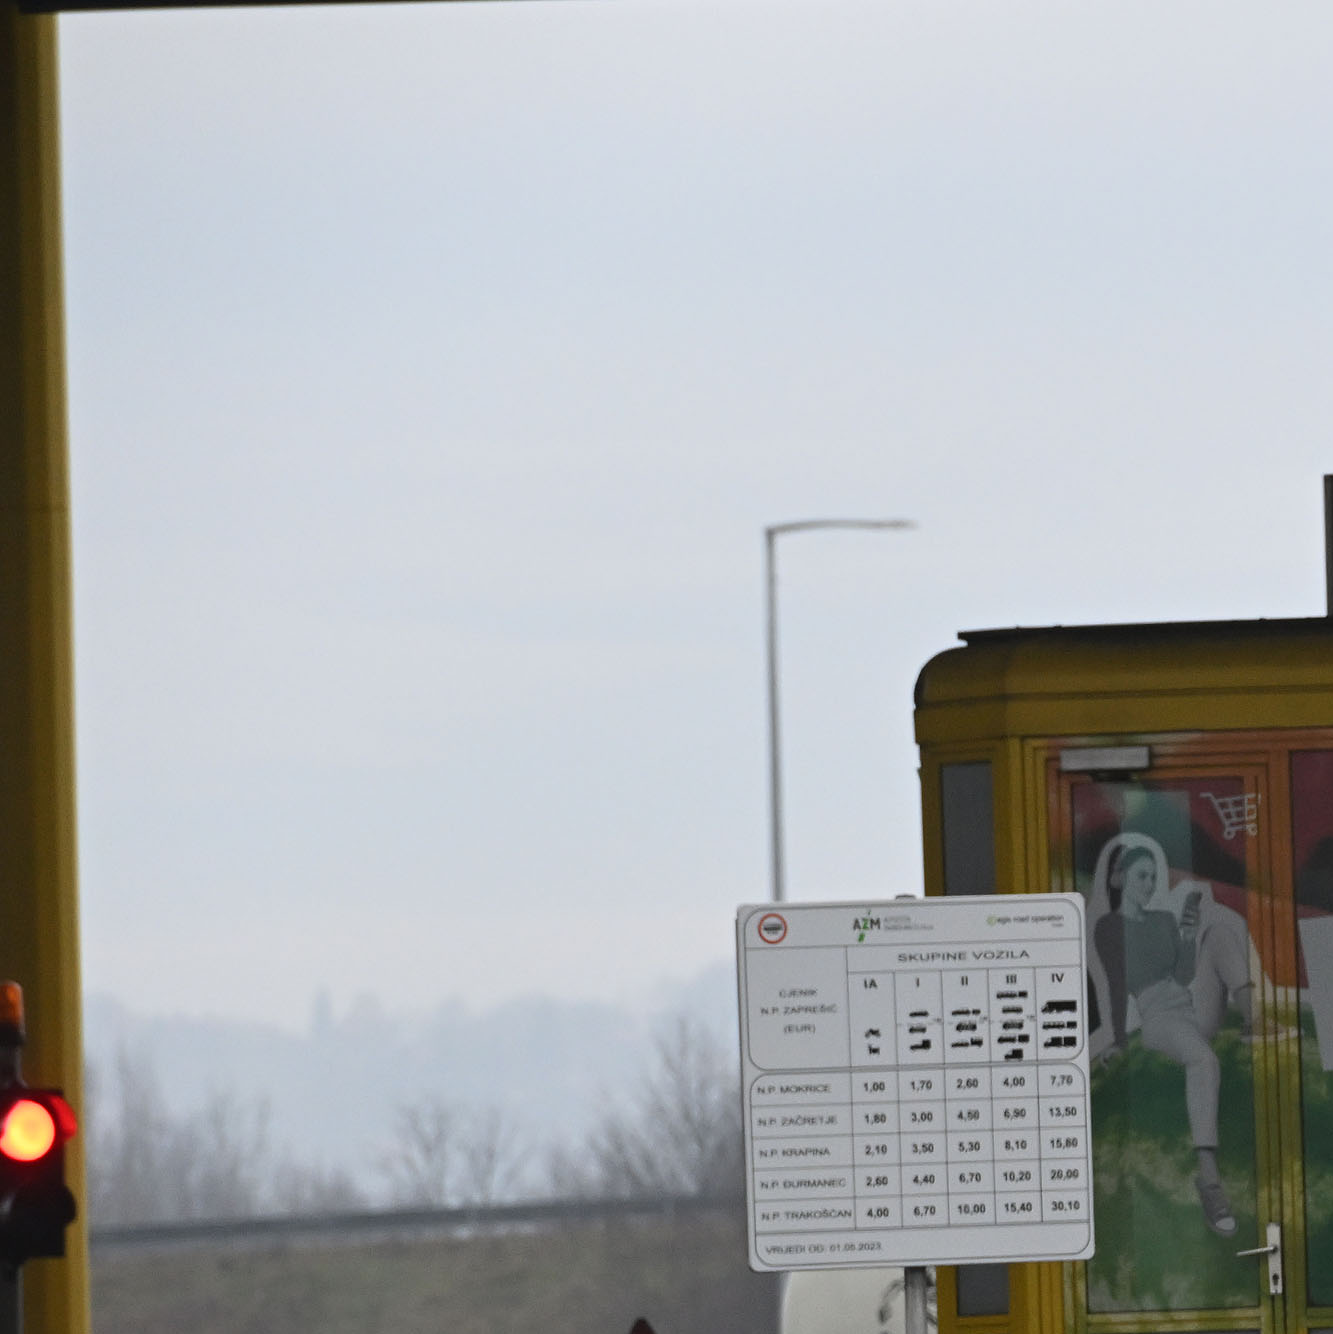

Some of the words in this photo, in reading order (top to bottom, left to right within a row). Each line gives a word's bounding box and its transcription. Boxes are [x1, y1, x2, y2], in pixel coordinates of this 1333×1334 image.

[898, 952, 966, 962] SKUPINE
[973, 950, 1029, 960] VOZILA
[864, 979, 877, 988] IA
[1052, 973, 1064, 982] IV
[784, 1024, 815, 1033] (EUR)
[780, 1085, 828, 1094] MOKRICE
[864, 1082, 885, 1092] 1,00
[911, 1080, 932, 1090] 1,70
[957, 1078, 978, 1089] 2,60
[1003, 1077, 1025, 1087] 4,00
[1051, 1075, 1073, 1086] 7,70
[865, 1114, 886, 1124] 1,80
[912, 1112, 933, 1122] 3,00
[1004, 1108, 1026, 1120] 6,90
[782, 1148, 830, 1156] KRAPINA
[866, 1145, 887, 1155] 2,10
[913, 1143, 934, 1154] 3,50
[959, 1141, 980, 1152] 5,30
[1005, 1140, 1027, 1150] 8,10
[867, 1176, 888, 1187] 2,60
[913, 1175, 935, 1185] 4,40
[959, 1173, 981, 1183] 6,70
[1004, 1171, 1031, 1182] 10,20
[1051, 1169, 1079, 1180] 20,00
[867, 1208, 889, 1218] 4,00
[914, 1206, 935, 1216] 6,70
[958, 1204, 985, 1214] 10,00
[1005, 1202, 1032, 1213] 15,40
[1052, 1201, 1080, 1211] 30,10
